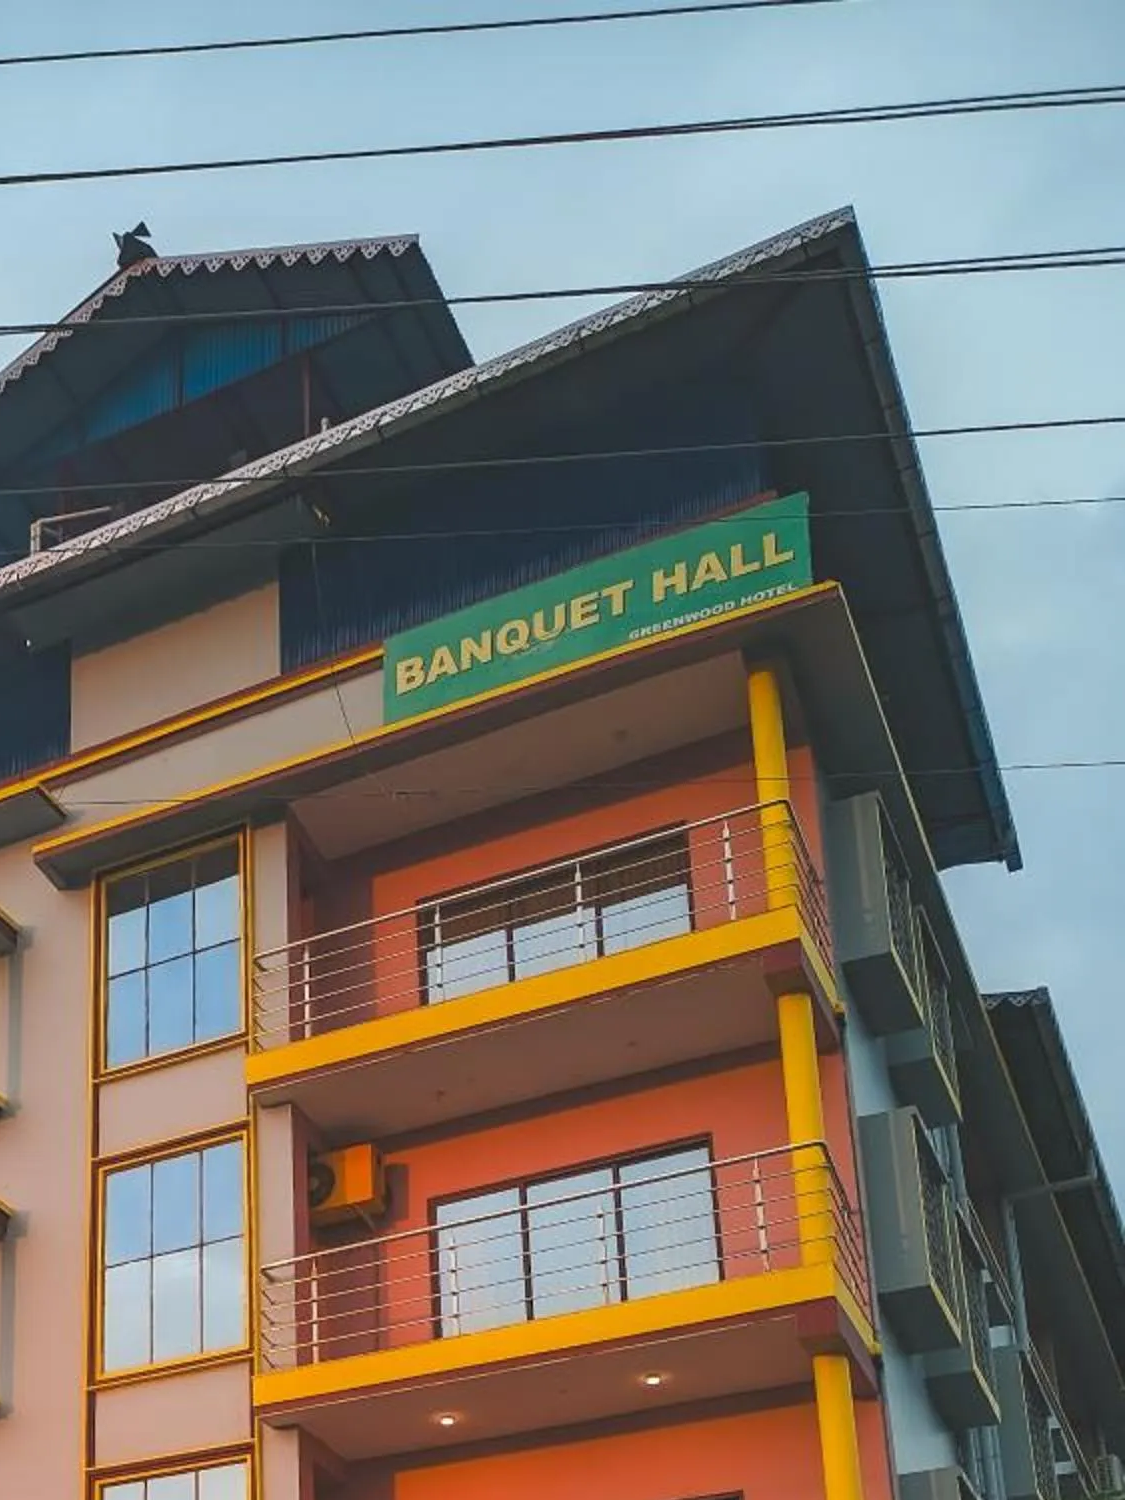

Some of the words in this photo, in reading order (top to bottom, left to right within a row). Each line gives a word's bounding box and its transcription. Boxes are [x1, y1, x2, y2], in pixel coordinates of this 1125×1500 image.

[395, 579, 635, 695] BANQUET
[651, 532, 795, 602] HALL
[628, 600, 736, 640] GREENWOOD
[740, 583, 798, 607] HOTEL
